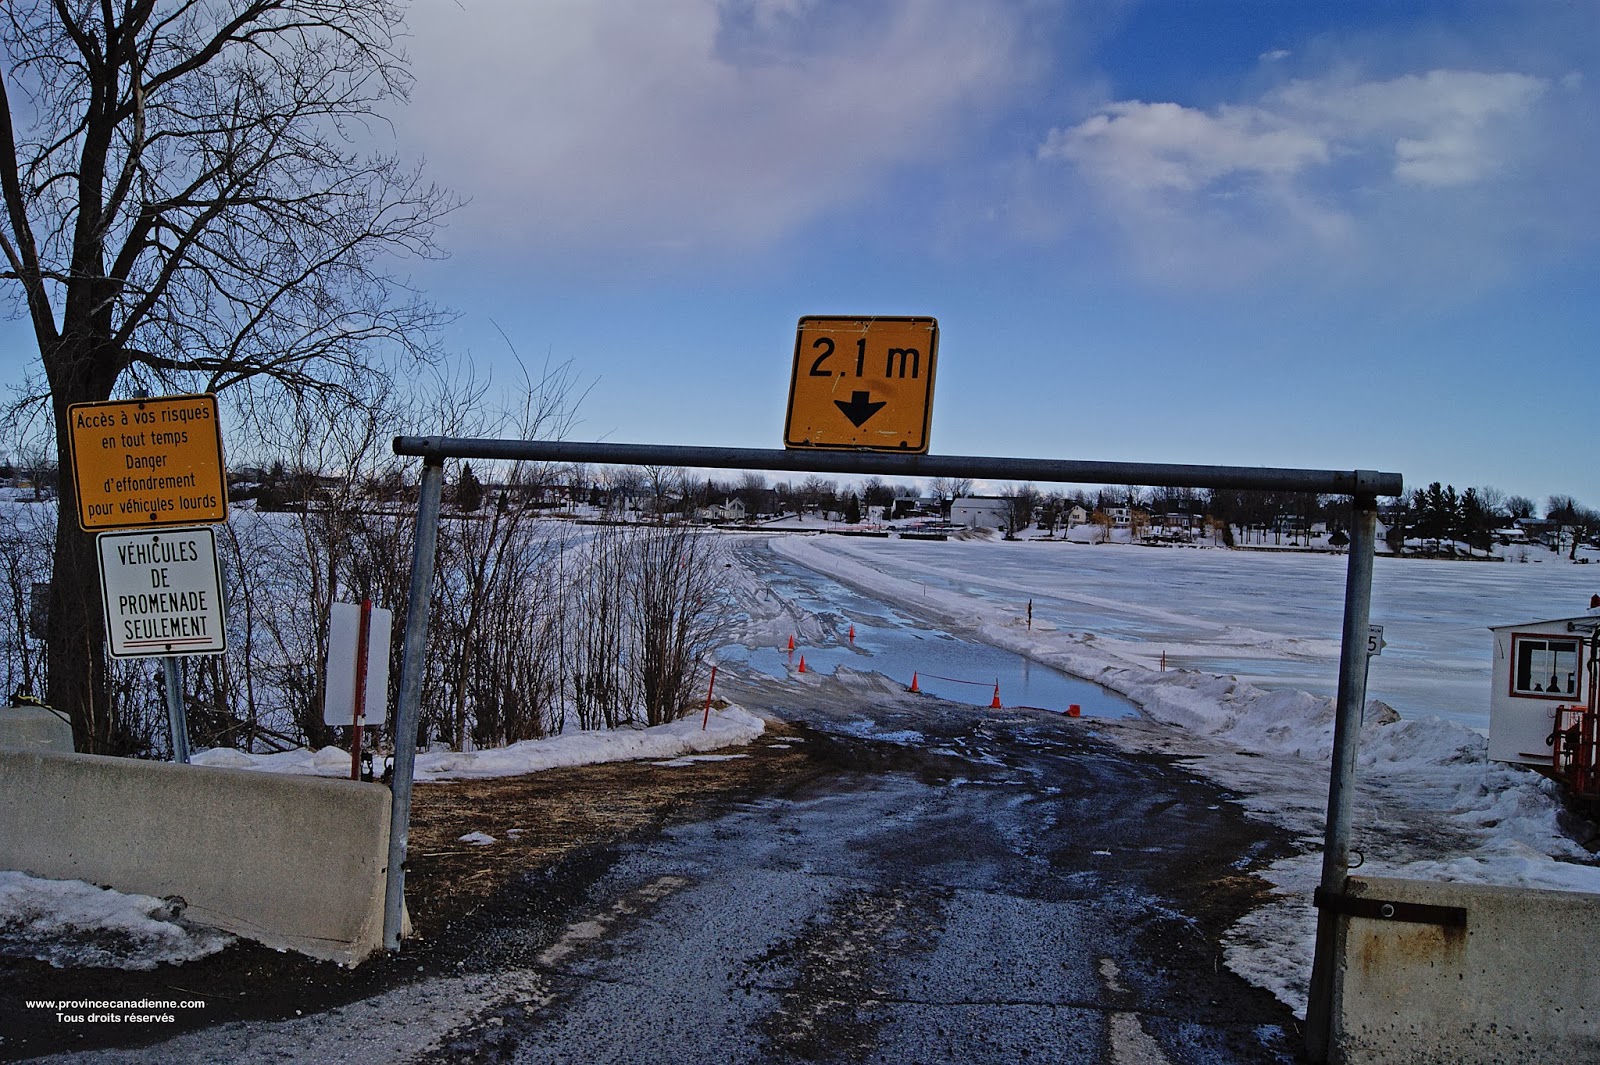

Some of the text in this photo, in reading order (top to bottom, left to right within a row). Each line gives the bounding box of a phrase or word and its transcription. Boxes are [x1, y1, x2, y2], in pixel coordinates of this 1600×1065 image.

[809, 337, 920, 378] 2.1 m
[77, 407, 210, 429] Accès à vos risques
[102, 430, 188, 449] en tout temps
[125, 454, 168, 472] Danger
[104, 473, 196, 493] d'effondrement
[88, 494, 217, 519] pour véhicules lourds
[117, 541, 198, 566] VÉHICULES
[151, 568, 170, 589] DE
[119, 591, 208, 616] PROMENADE
[124, 616, 207, 640] SEULEMENT
